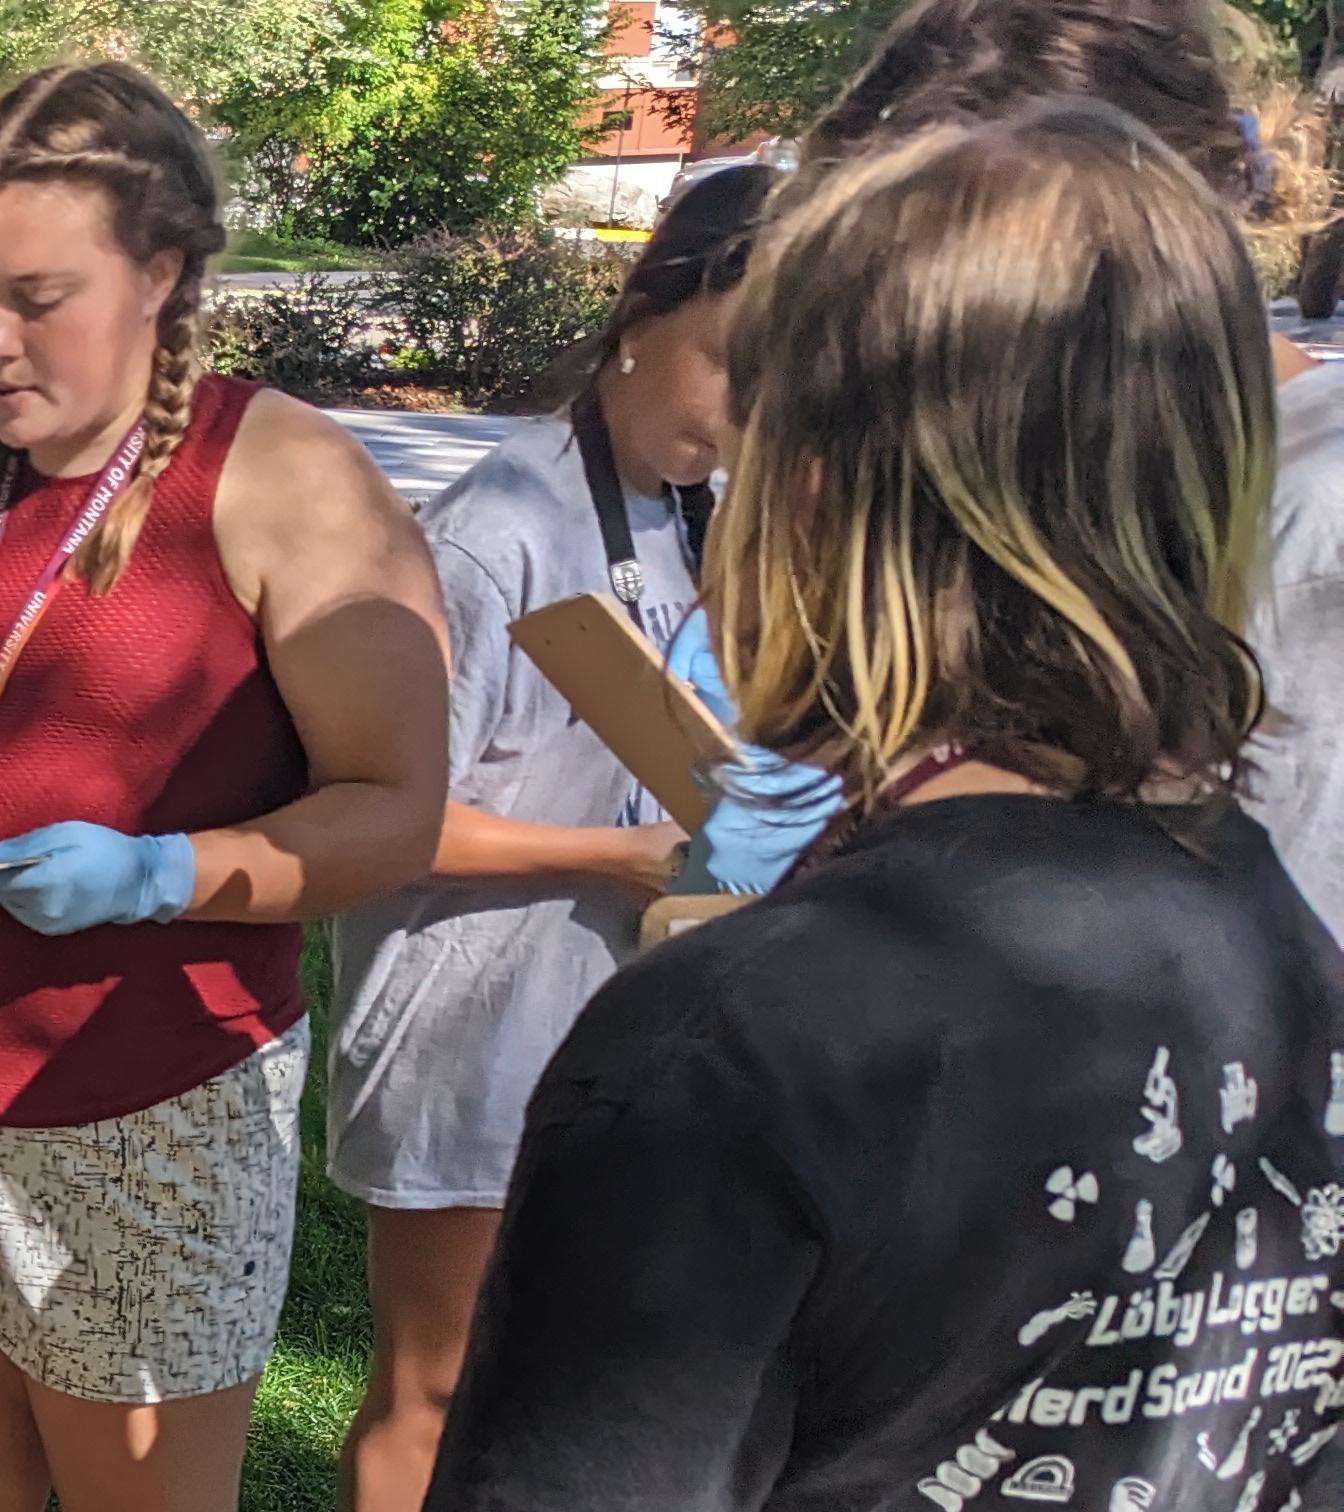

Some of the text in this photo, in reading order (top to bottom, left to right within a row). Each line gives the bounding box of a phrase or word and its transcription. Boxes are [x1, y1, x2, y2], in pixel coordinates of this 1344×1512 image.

[108, 467, 125, 490] OF
[63, 486, 114, 555] MONTANA
[0, 591, 47, 673] UNIVERSITY
